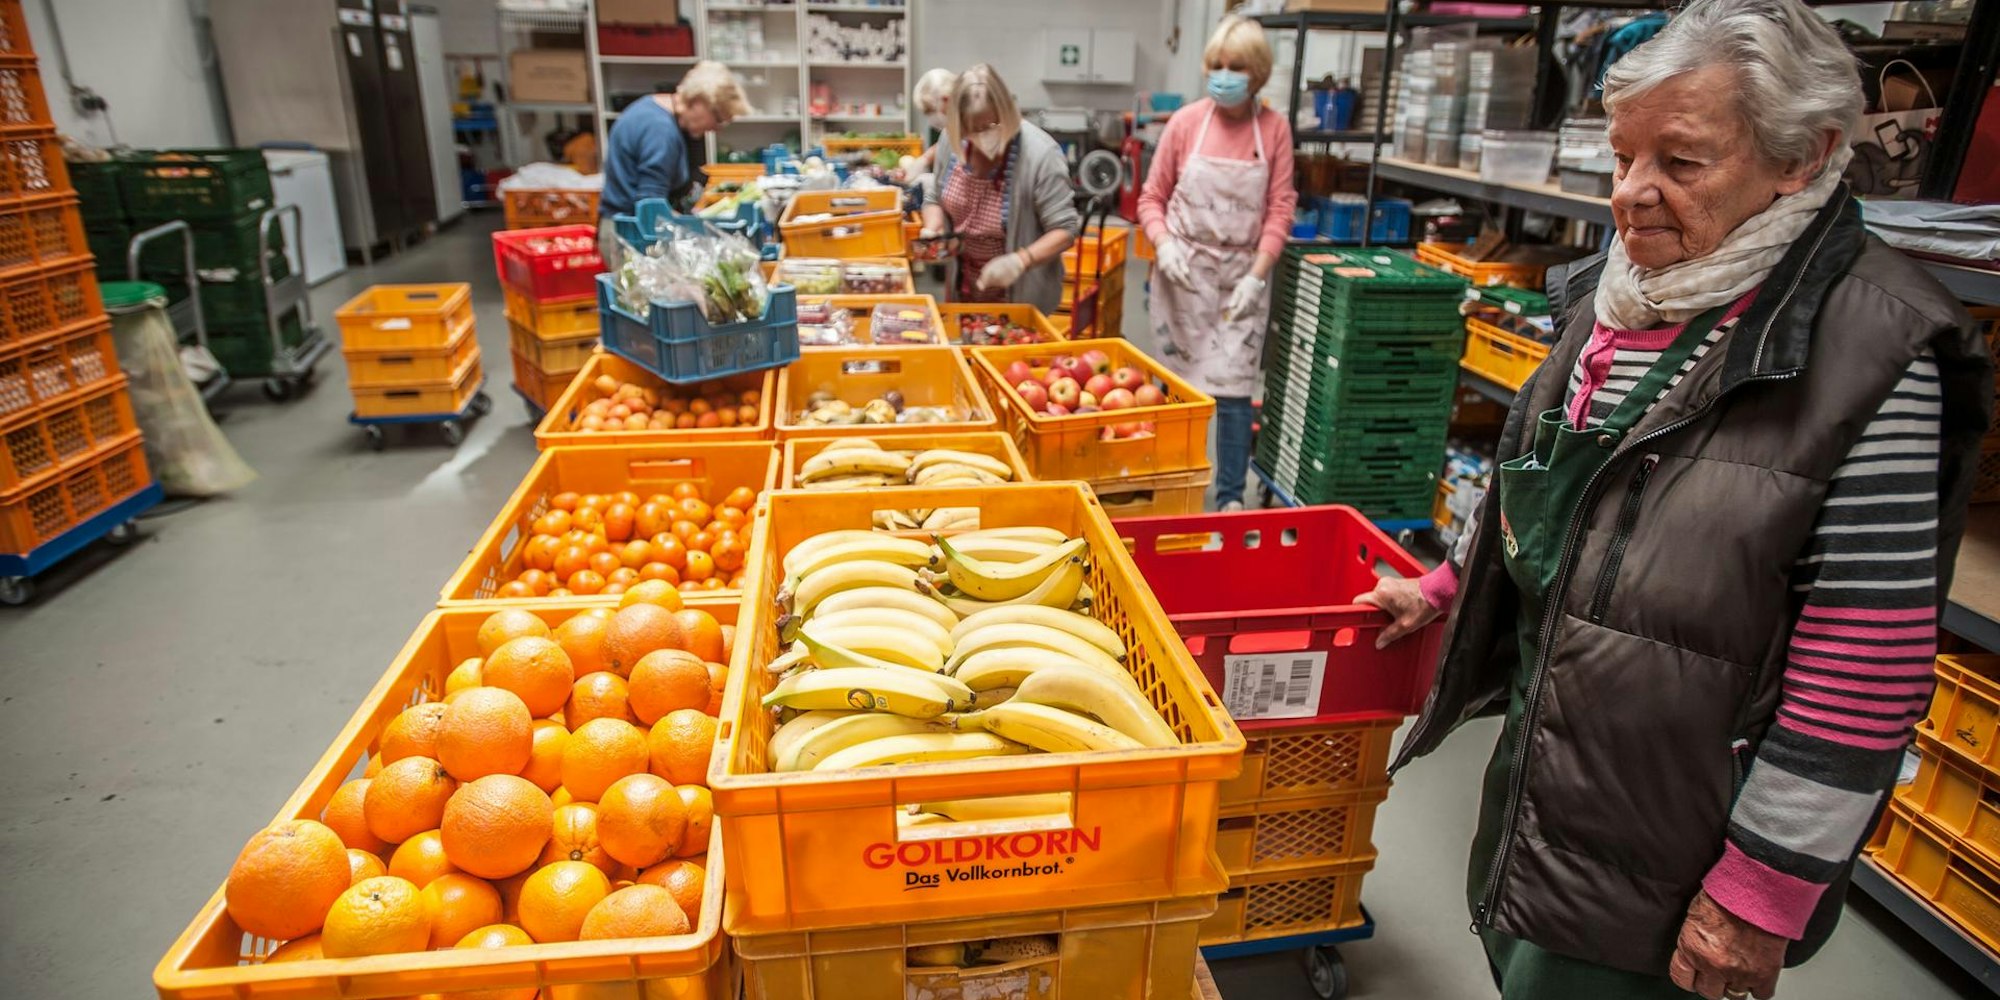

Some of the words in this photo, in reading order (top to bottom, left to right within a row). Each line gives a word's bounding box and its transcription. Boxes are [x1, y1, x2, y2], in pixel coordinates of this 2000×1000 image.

[863, 826, 1101, 870] GOLDKORN
[905, 871, 940, 886] Das
[946, 861, 1064, 882] Vollkornbrot.
